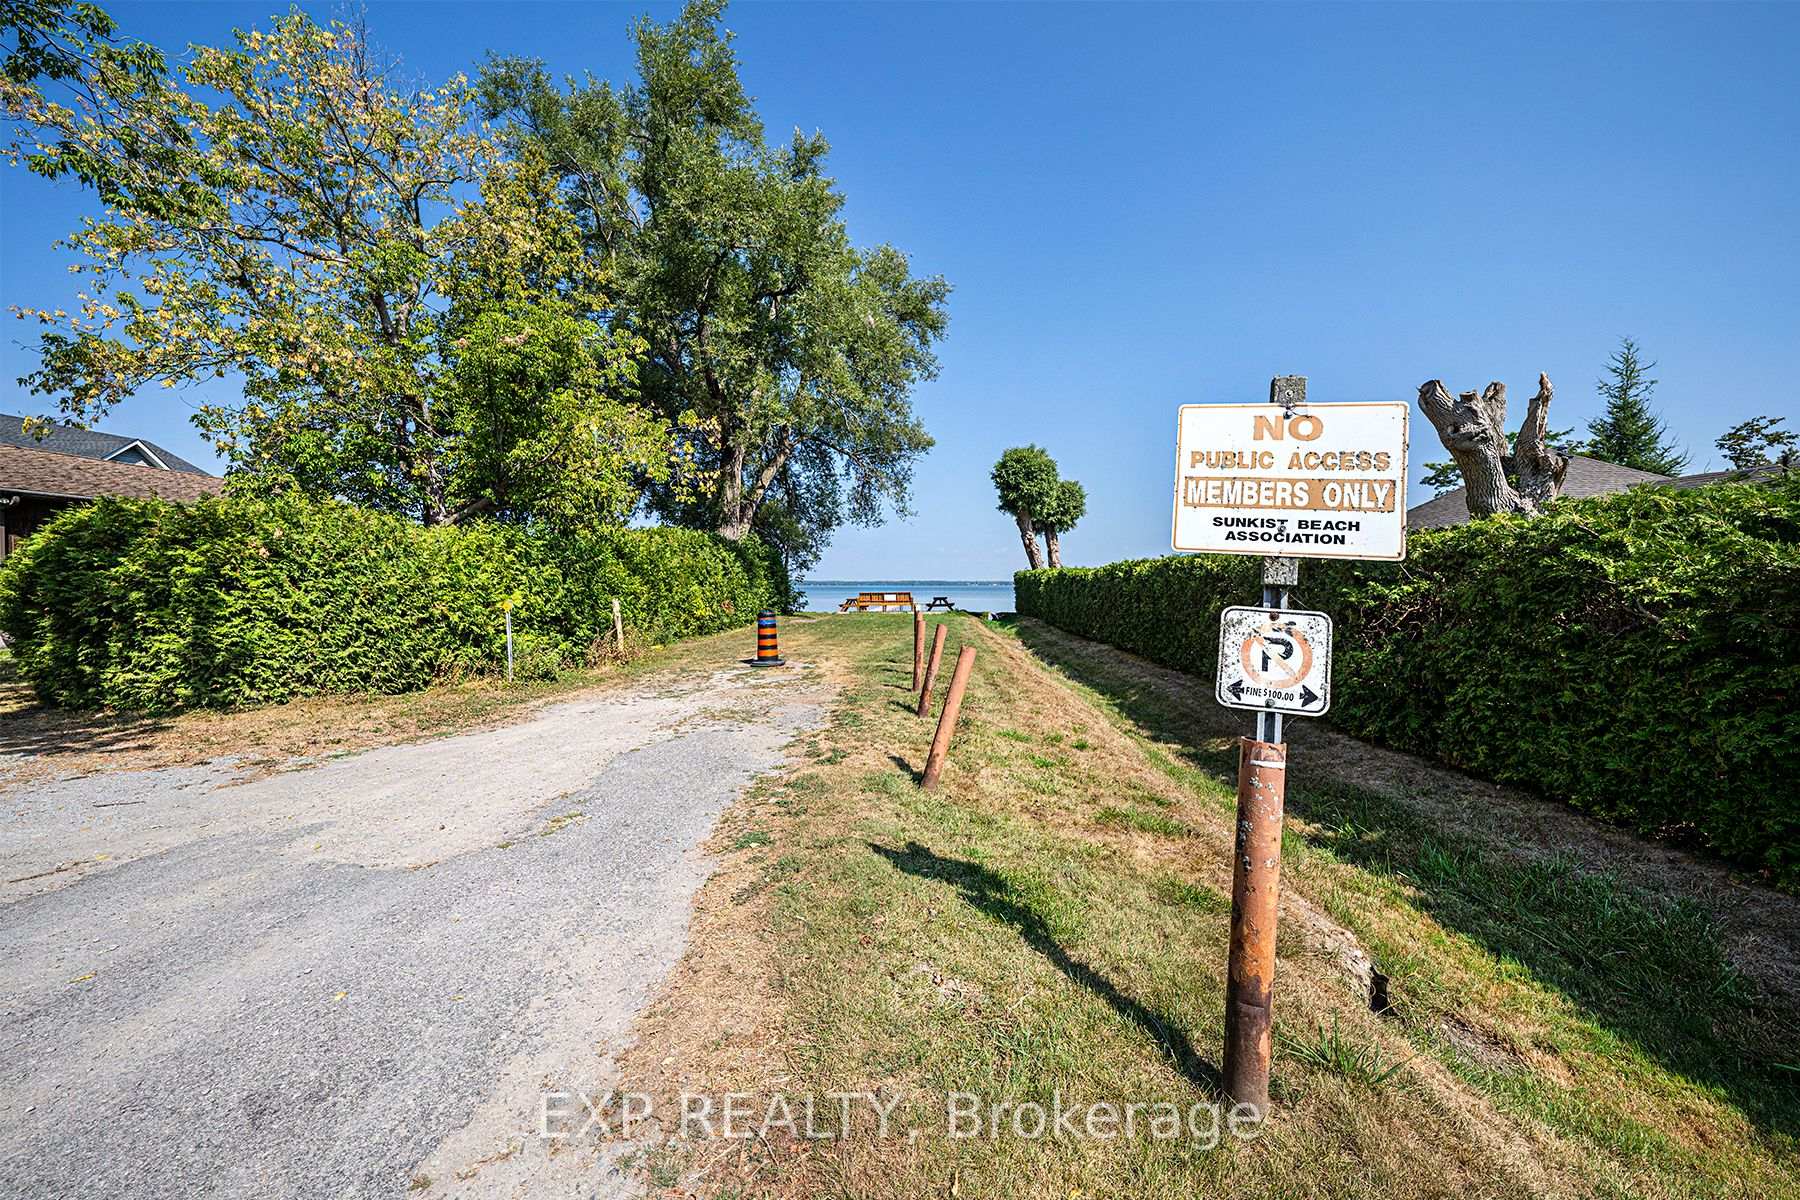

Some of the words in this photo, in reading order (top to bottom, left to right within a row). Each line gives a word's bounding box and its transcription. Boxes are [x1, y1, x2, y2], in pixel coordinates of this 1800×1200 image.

[1253, 415, 1324, 441] NO
[1190, 450, 1274, 469] PUBLIC
[1288, 451, 1391, 471] ACCESS
[1186, 480, 1310, 507] MEMBERS
[1323, 481, 1392, 508] ONLY
[1212, 516, 1288, 530] SUNKIST
[1298, 519, 1361, 531] BEACH
[1225, 530, 1346, 545] ASSOCIATION
[1245, 686, 1261, 697] FINE
[1263, 688, 1294, 701] $100.00
